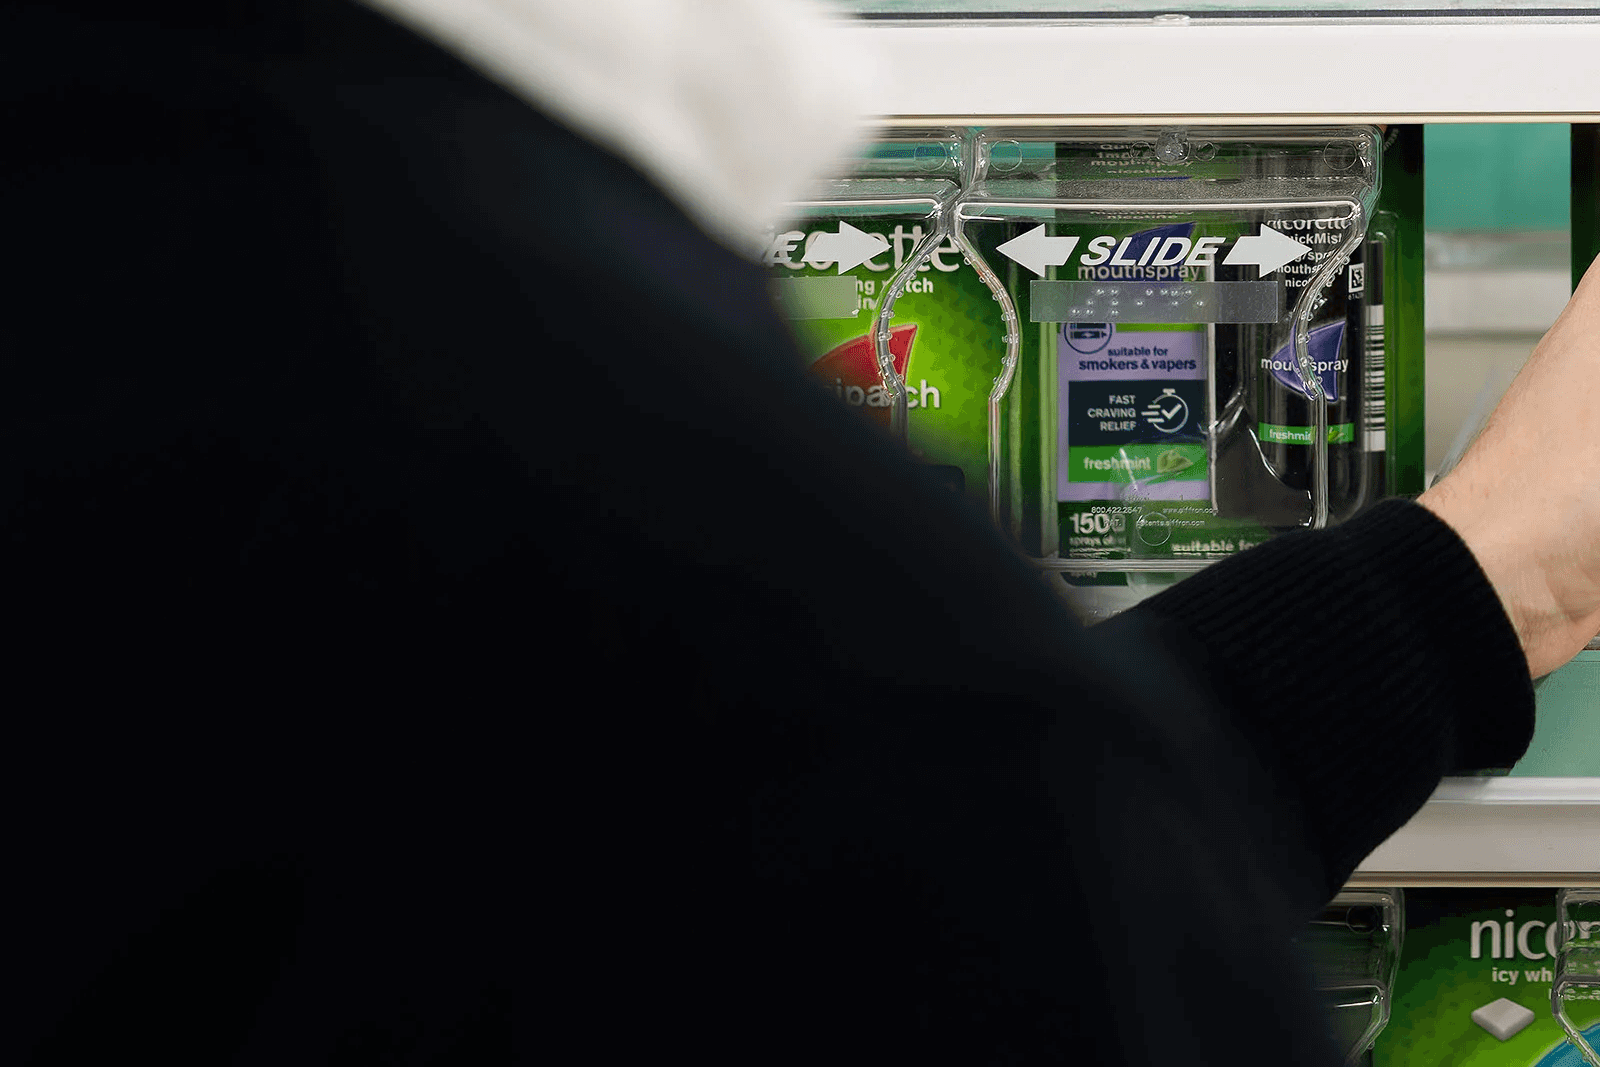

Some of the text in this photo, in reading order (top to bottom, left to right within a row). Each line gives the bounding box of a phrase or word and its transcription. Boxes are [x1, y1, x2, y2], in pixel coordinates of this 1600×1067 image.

[1079, 236, 1227, 266] SLIDE
[1107, 345, 1169, 357] suitable for
[1078, 358, 1197, 372] smokers & vapers
[1108, 395, 1136, 405] FAST
[1087, 408, 1136, 418] CRAVING
[1100, 421, 1137, 432] RELIEF
[1491, 967, 1519, 985] icy
